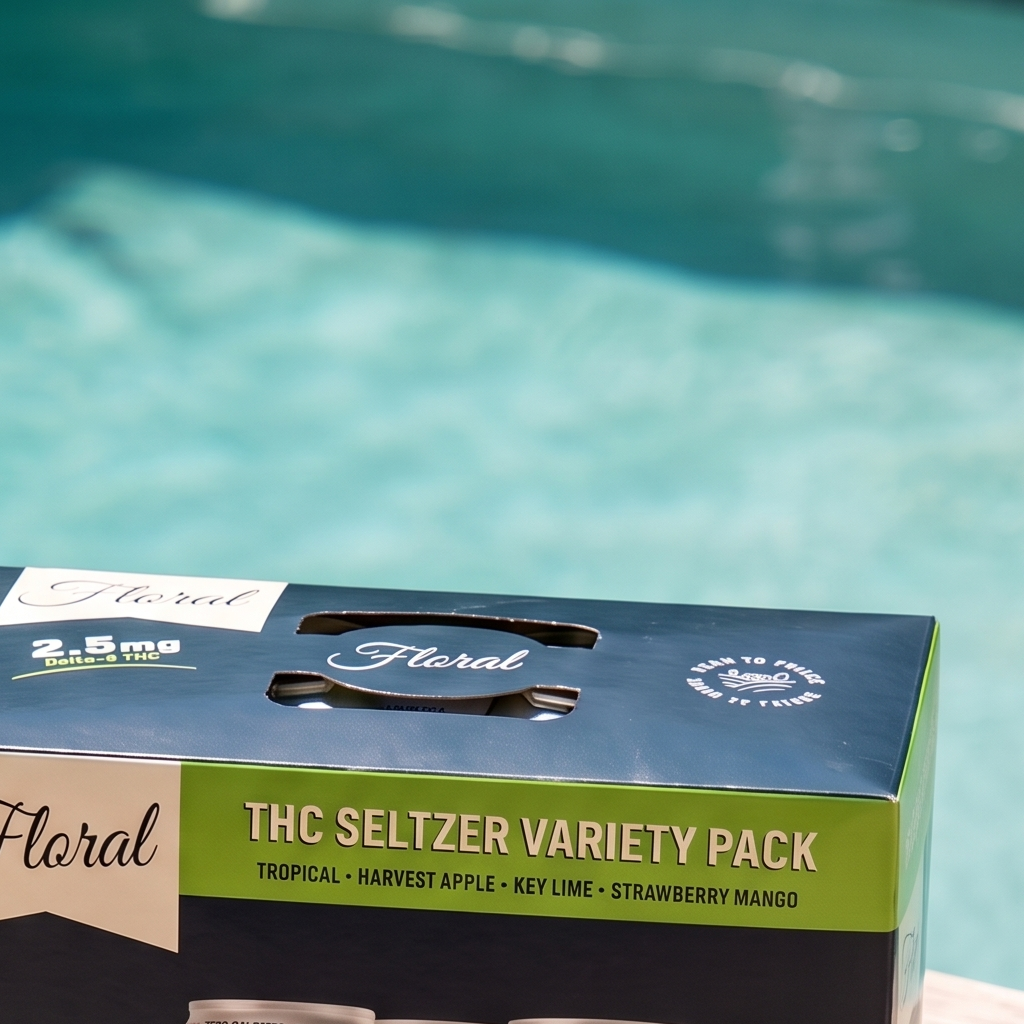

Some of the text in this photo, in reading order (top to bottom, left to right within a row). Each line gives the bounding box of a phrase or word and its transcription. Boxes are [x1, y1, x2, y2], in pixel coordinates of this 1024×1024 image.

[17, 580, 260, 607] Floral
[31, 635, 181, 659] 2.5mg
[123, 652, 160, 662] THC
[327, 641, 529, 671] Floral
[243, 801, 818, 872] THC SELTZER VARIETY PACK
[257, 862, 798, 909] TROPICAL HARVEST APPLE KEY LIME STRAWBERRY MANGO
